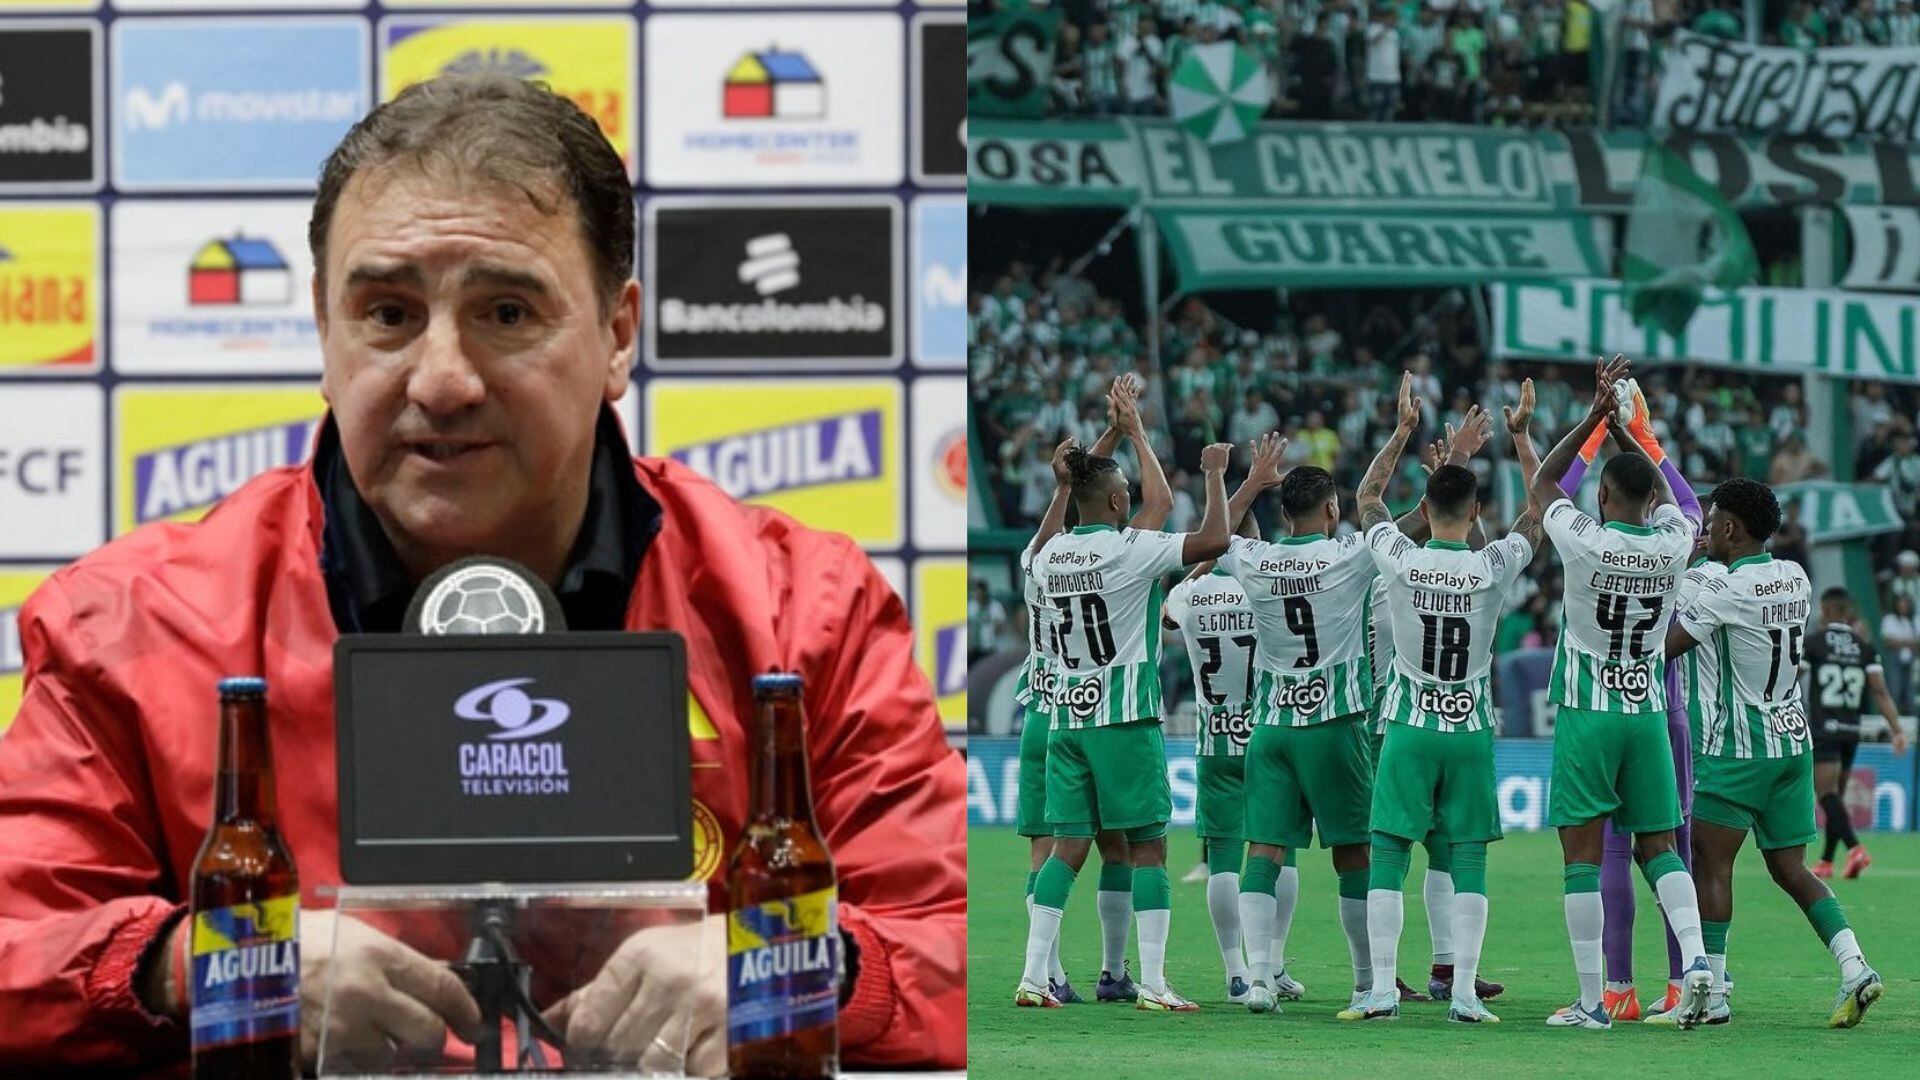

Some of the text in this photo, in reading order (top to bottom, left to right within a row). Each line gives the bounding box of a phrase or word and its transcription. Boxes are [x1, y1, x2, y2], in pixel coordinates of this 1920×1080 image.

[976, 142, 1121, 186] OSA
[1145, 128, 1539, 199] EL CARMELO
[1220, 220, 1548, 269] GUARNE
[661, 295, 885, 333] Bancolombia
[143, 418, 313, 518] AGUIL
[1049, 551, 1087, 565] BetPlay
[1260, 559, 1313, 574] BetPlay
[1602, 551, 1660, 571] BetPlay
[1048, 572, 1104, 593] BANGUERO
[1409, 569, 1466, 589] BetPlay
[1755, 577, 1794, 597] BetPlay
[1191, 592, 1244, 607] BetPlay
[1413, 590, 1472, 614] OLIVERA
[1052, 593, 1117, 669] 20
[1198, 612, 1255, 632] S.GOMEZ
[1284, 596, 1319, 668] 9
[1595, 593, 1664, 661] 42
[1419, 614, 1471, 682] 18
[1196, 635, 1257, 705] 27
[1600, 664, 1650, 704] tigo
[1817, 663, 1866, 710] 23
[1277, 677, 1327, 717] tigo
[1419, 689, 1474, 724] tigo
[460, 742, 568, 777] CARACOL
[462, 776, 569, 796] TELEVISIÓN
[204, 941, 296, 989] AGUILA
[740, 934, 831, 987] AGUILA
